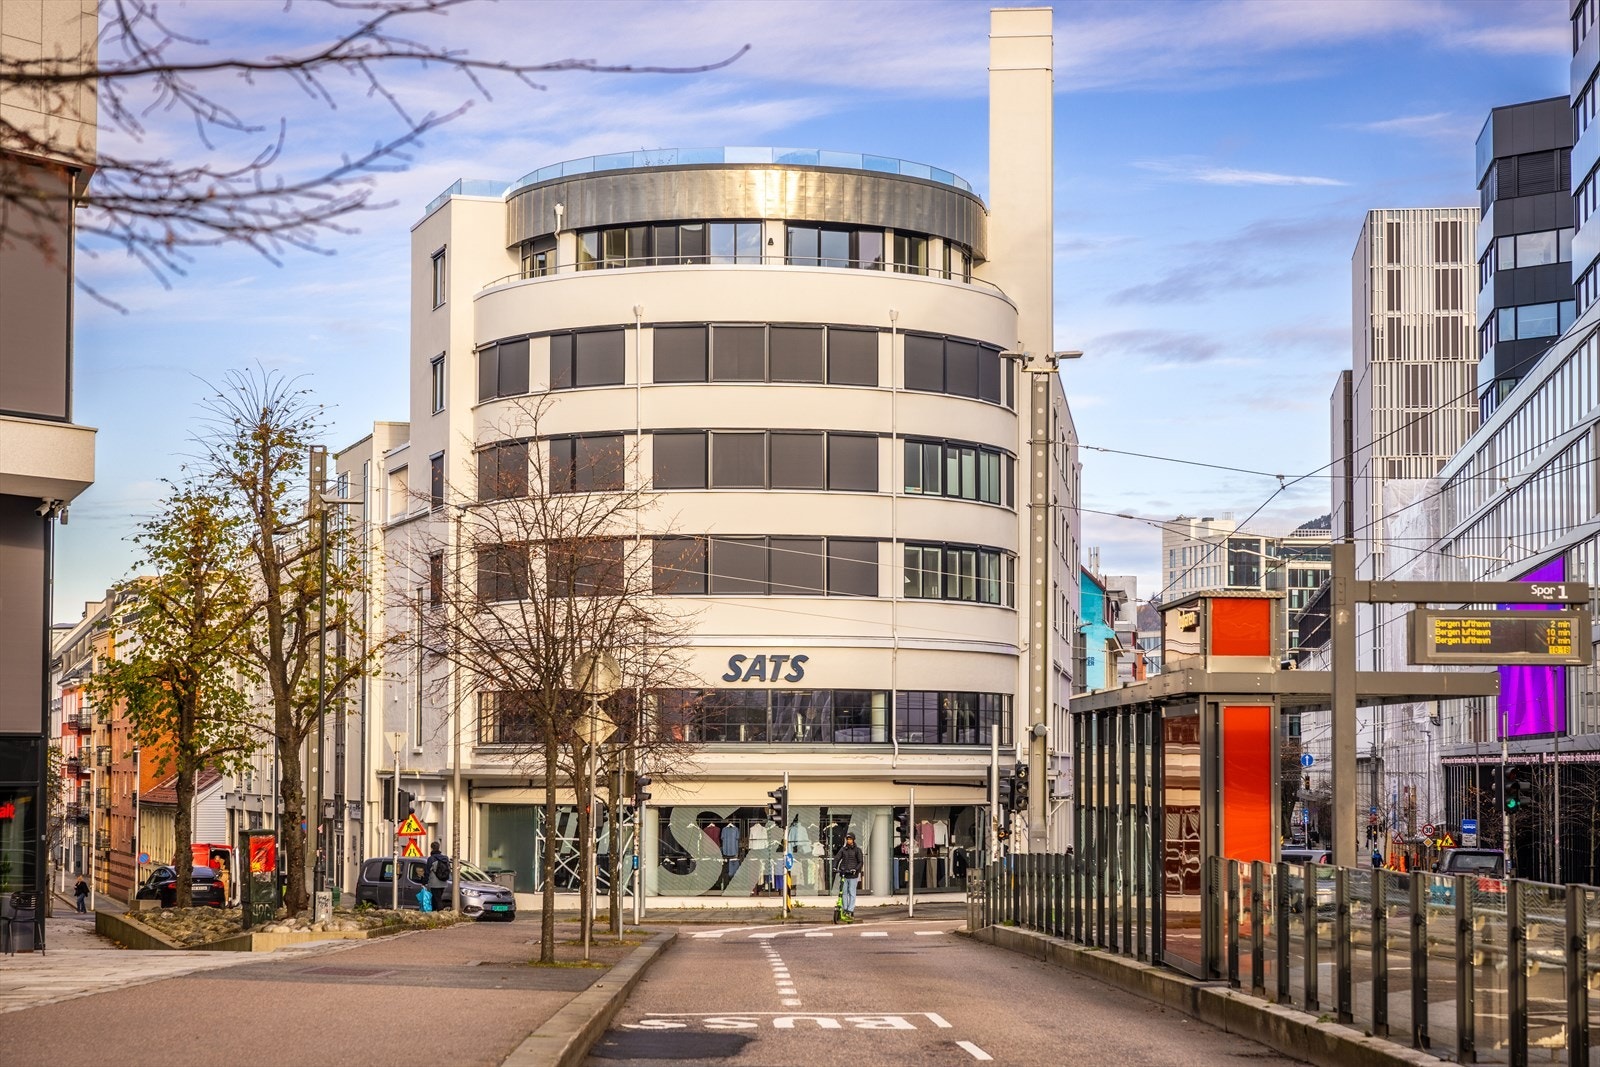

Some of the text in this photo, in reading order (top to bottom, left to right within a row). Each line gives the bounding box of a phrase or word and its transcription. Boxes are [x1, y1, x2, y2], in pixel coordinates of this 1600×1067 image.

[1531, 584, 1568, 599] Spor 1
[1435, 619, 1570, 628] Bergen lufthavn 2 min
[1435, 628, 1460, 637] Bergen
[1461, 628, 1491, 636] lufthavn
[1546, 628, 1556, 636] 10
[1435, 636, 1570, 645] Bergen lufthavn 17 min
[721, 654, 809, 683] SATS
[1424, 826, 1433, 834] 30
[620, 1015, 918, 1031] BUSS
